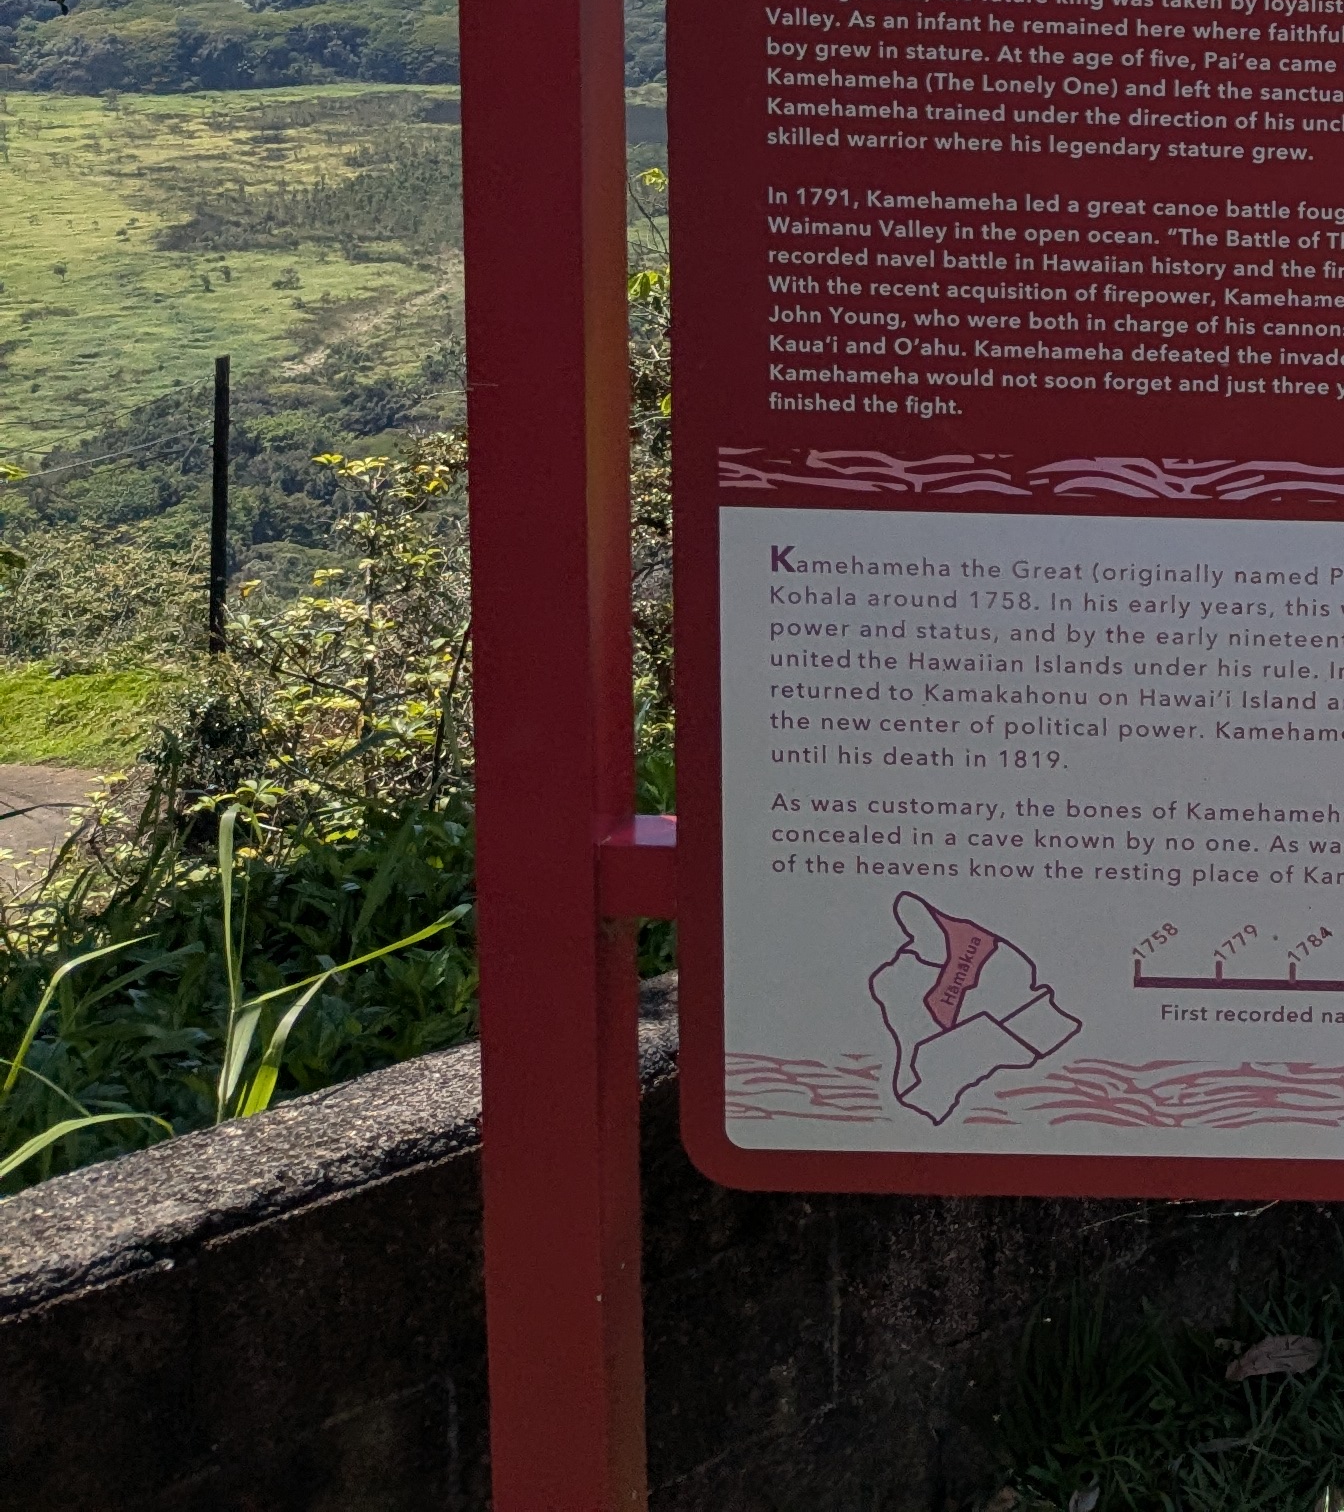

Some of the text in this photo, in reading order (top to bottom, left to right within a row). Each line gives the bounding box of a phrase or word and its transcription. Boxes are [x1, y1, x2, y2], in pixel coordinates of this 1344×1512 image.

[765, 7, 840, 31] Valley.
[848, 10, 875, 27] As
[883, 16, 908, 28] an
[917, 12, 981, 31] infant
[988, 14, 1015, 32] he
[1023, 18, 1128, 36] remained
[1136, 19, 1185, 38] here
[1192, 21, 1261, 40] where
[767, 126, 1313, 164] skilled warrior where his legendary stature grew.
[769, 247, 868, 265] recorded
[877, 250, 934, 267] navel
[943, 250, 1007, 269] battle
[1015, 253, 1034, 270] in
[1043, 254, 1143, 273] Hawaiian
[1152, 256, 1226, 280] history
[1233, 259, 1273, 277] and
[1281, 260, 1316, 278] the
[768, 275, 819, 293] With
[827, 276, 862, 295] the
[870, 282, 939, 297] recent
[947, 282, 1067, 303] acquisition
[1075, 284, 1097, 301] of
[1103, 284, 1216, 307] firepower,
[770, 364, 918, 384] Kamehameha
[927, 368, 993, 386] would
[1002, 373, 1037, 387] not
[1045, 376, 1096, 389] soon
[1104, 372, 1172, 395] forget
[1179, 374, 1219, 392] and
[1225, 376, 1266, 397] just
[1272, 376, 1329, 395] three
[769, 392, 962, 418] finished the fight.
[771, 586, 855, 605] Kohala
[868, 590, 956, 608] around
[970, 591, 1039, 610] 1758.
[1052, 593, 1071, 610] In
[1084, 593, 1117, 612] his
[1129, 595, 1190, 619] early
[1201, 602, 1273, 619] years,
[1285, 597, 1330, 617] this
[771, 650, 850, 670] united
[857, 652, 898, 670] the
[909, 652, 1023, 672] Hawaiian
[1036, 655, 1122, 675] Islands
[1135, 657, 1207, 676] under
[1218, 658, 1251, 677] his
[1263, 660, 1318, 679] rule.
[770, 710, 809, 729] the
[822, 718, 871, 730] new
[880, 717, 960, 732] center
[971, 715, 994, 733] of
[1005, 716, 1107, 739] political
[1119, 724, 1203, 742] power.
[772, 745, 1067, 768] until his death in 1819.
[772, 793, 800, 811] As
[811, 800, 856, 812] was
[868, 799, 1004, 821] customary,
[1016, 798, 1054, 817] the
[1067, 799, 1141, 818] bones
[1153, 801, 1177, 819] of
[1132, 923, 1178, 959] 1758
[1214, 924, 1257, 960] 1779
[1288, 926, 1333, 962] 1784
[1162, 1004, 1207, 1021] First
[1216, 1006, 1312, 1022] recorded
